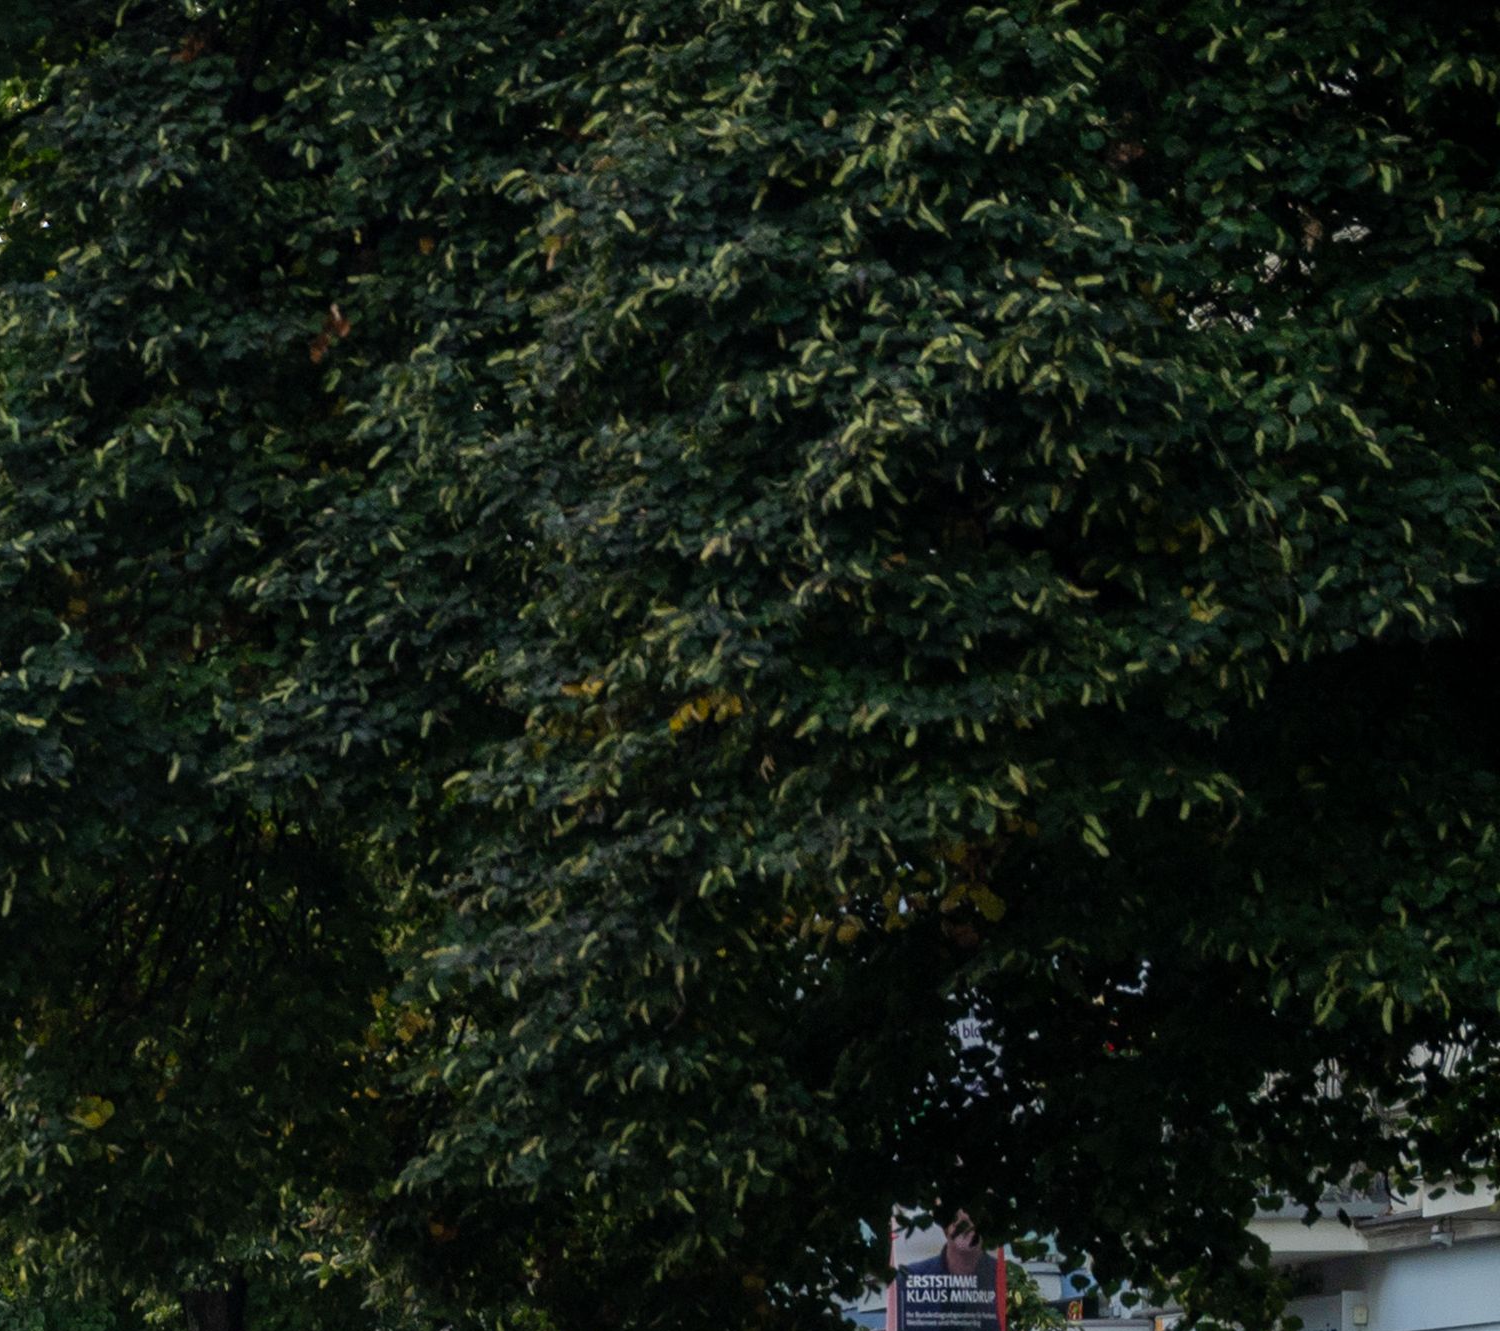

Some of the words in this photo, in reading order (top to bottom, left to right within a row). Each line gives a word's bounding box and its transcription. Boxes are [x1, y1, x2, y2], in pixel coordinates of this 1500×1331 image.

[906, 1275, 978, 1288] ERSTSTIMME
[906, 1289, 948, 1303] KLAUS
[950, 1290, 996, 1304] MINDRUP
